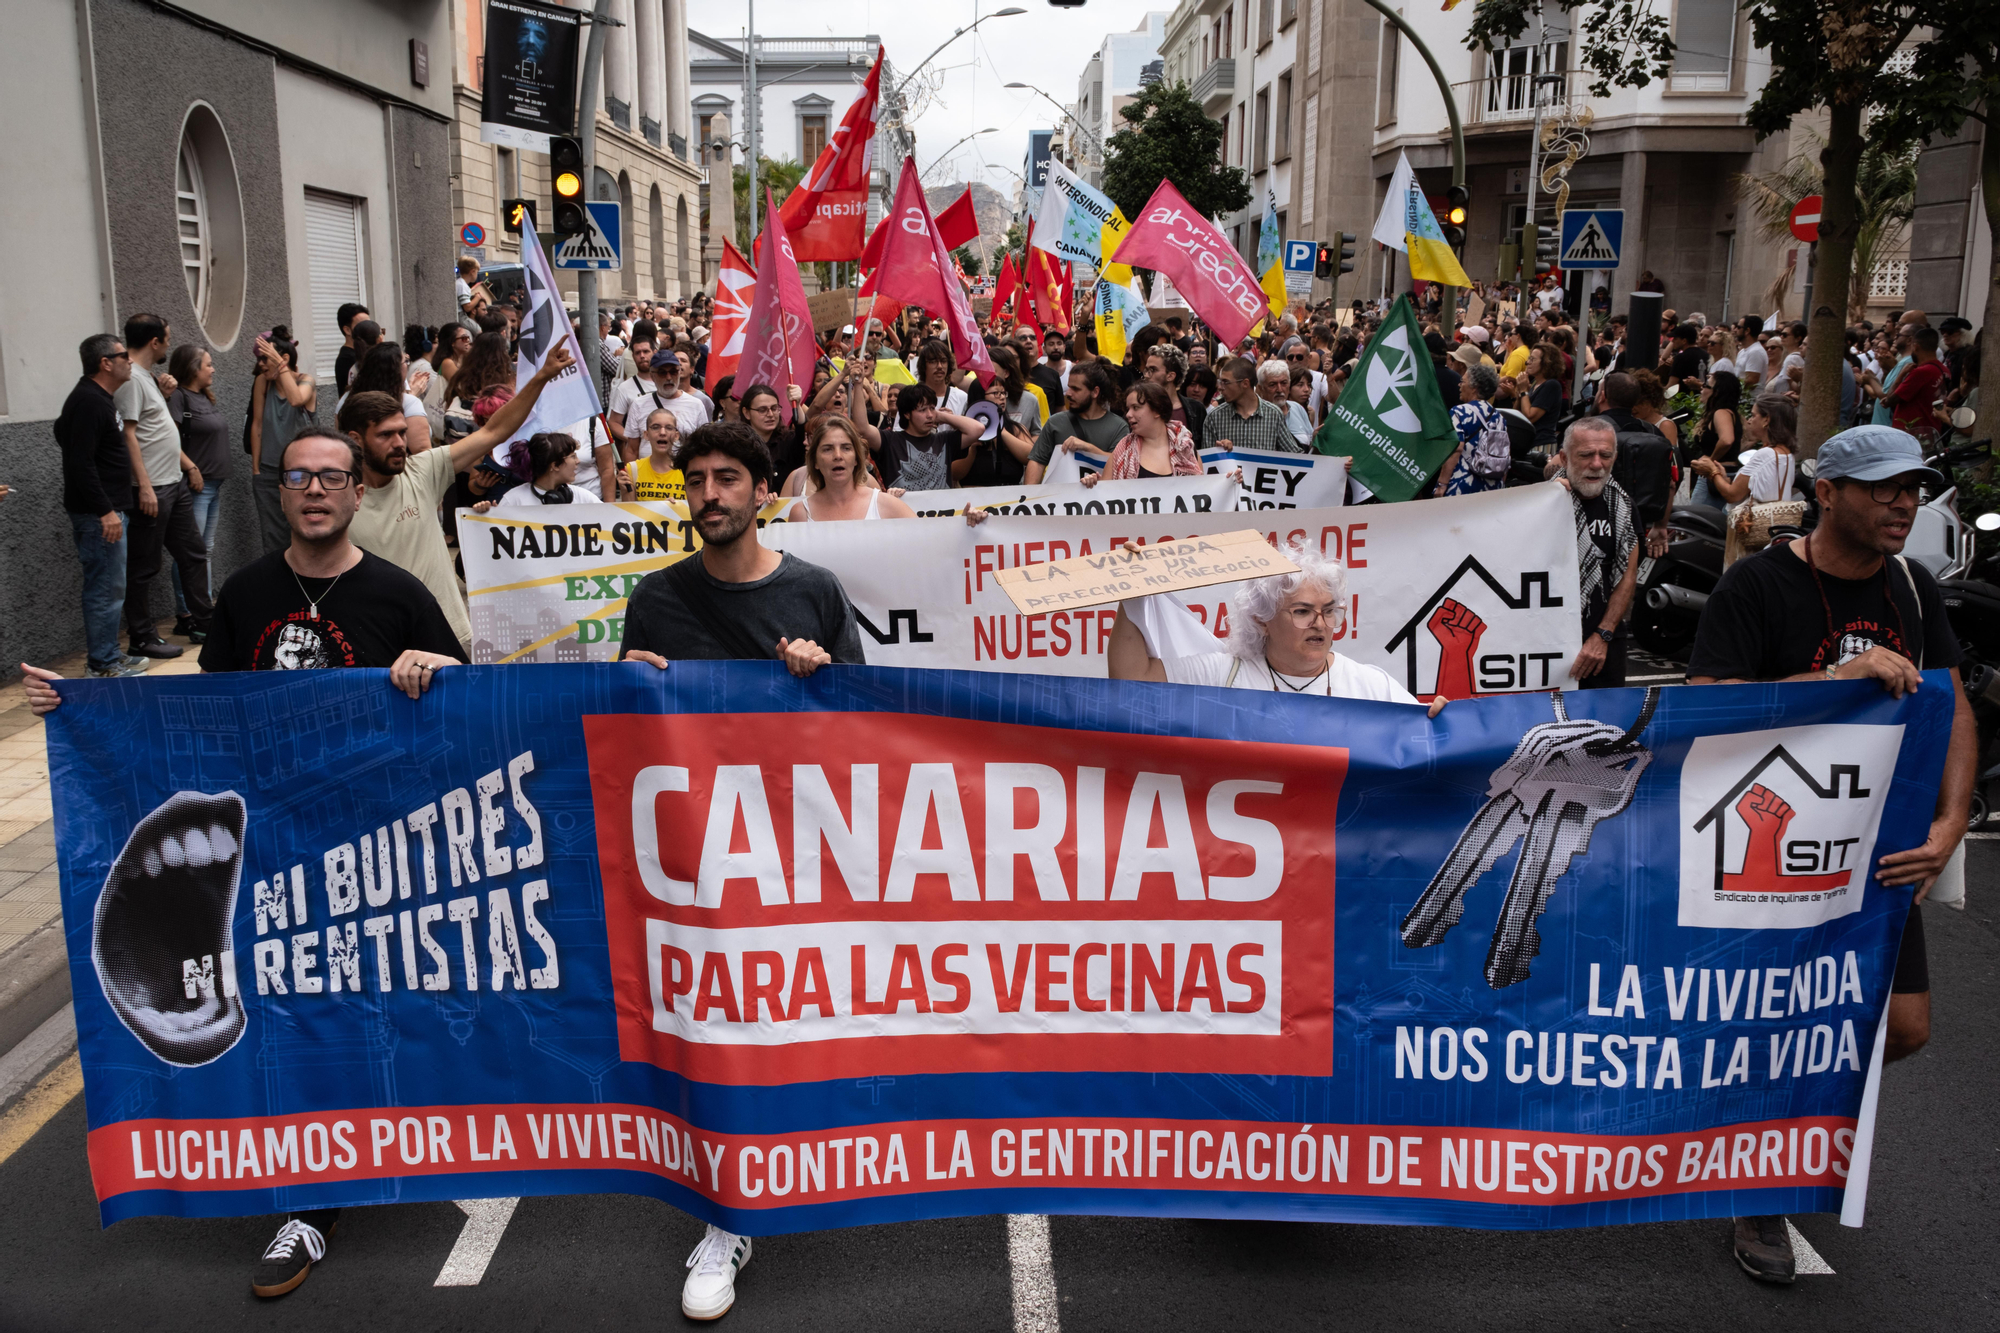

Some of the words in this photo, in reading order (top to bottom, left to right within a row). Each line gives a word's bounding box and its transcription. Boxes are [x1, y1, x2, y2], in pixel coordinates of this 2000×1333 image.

[490, 0, 508, 9] GRAN
[509, 5, 537, 16] ESTRENO
[547, 13, 577, 25] CANARIAS
[1054, 175, 1122, 232] INTERSINDICAL
[1148, 207, 1220, 248] abrir
[1290, 244, 1310, 268] P
[1100, 277, 1114, 327] RSINDICAL
[1335, 404, 1427, 481] anticapitalistas
[635, 482, 654, 490] QUE
[1373, 449, 1419, 489] www.anticapitalistas.org
[636, 491, 670, 499] ROBEN
[489, 522, 604, 560] NADIE
[611, 520, 670, 556] SIN
[677, 520, 696, 552] T
[1320, 522, 1368, 569] DE
[1021, 564, 1070, 585] LA
[1109, 563, 1148, 578] ES
[1164, 555, 1198, 577] UN
[326, 620, 355, 666] TECH
[973, 609, 1118, 662] NUESTR
[1478, 652, 1563, 690] SIT
[253, 864, 308, 936] NI
[323, 750, 544, 918] BUITRES
[631, 761, 1285, 909] CANARIAS
[1785, 837, 1860, 874] SIT
[1714, 892, 1756, 902] Sindicato
[1758, 893, 1768, 903] de
[1771, 893, 1809, 905] Inquilinas
[1811, 892, 1821, 902] de
[1823, 887, 1848, 900] Tenerife
[182, 950, 236, 999] NI
[253, 879, 559, 996] RENTISTAS
[660, 940, 836, 1023] PARA
[848, 942, 972, 1016] LAS
[986, 941, 1266, 1014] VECINAS
[1588, 962, 1646, 1019] LA
[1663, 950, 1863, 1022] VIVIENDA
[1394, 1024, 1489, 1083] NOS
[1505, 1028, 1683, 1091] CUESTA
[1700, 1037, 1750, 1089] LA
[1768, 1018, 1862, 1079] VIDA
[130, 1118, 359, 1181] LUCHAMOS
[369, 1113, 455, 1168] POR
[467, 1113, 518, 1162] LA
[526, 1112, 701, 1185] VIVIENDA
[701, 1138, 726, 1193] Y
[738, 1132, 910, 1198] CONTRA
[925, 1129, 975, 1182] LA
[990, 1124, 1348, 1184] GENTRIFICACIÓN
[1367, 1134, 1422, 1187] DE
[1439, 1137, 1668, 1195] NUESTROS
[1676, 1126, 1857, 1185] BARRIOS
